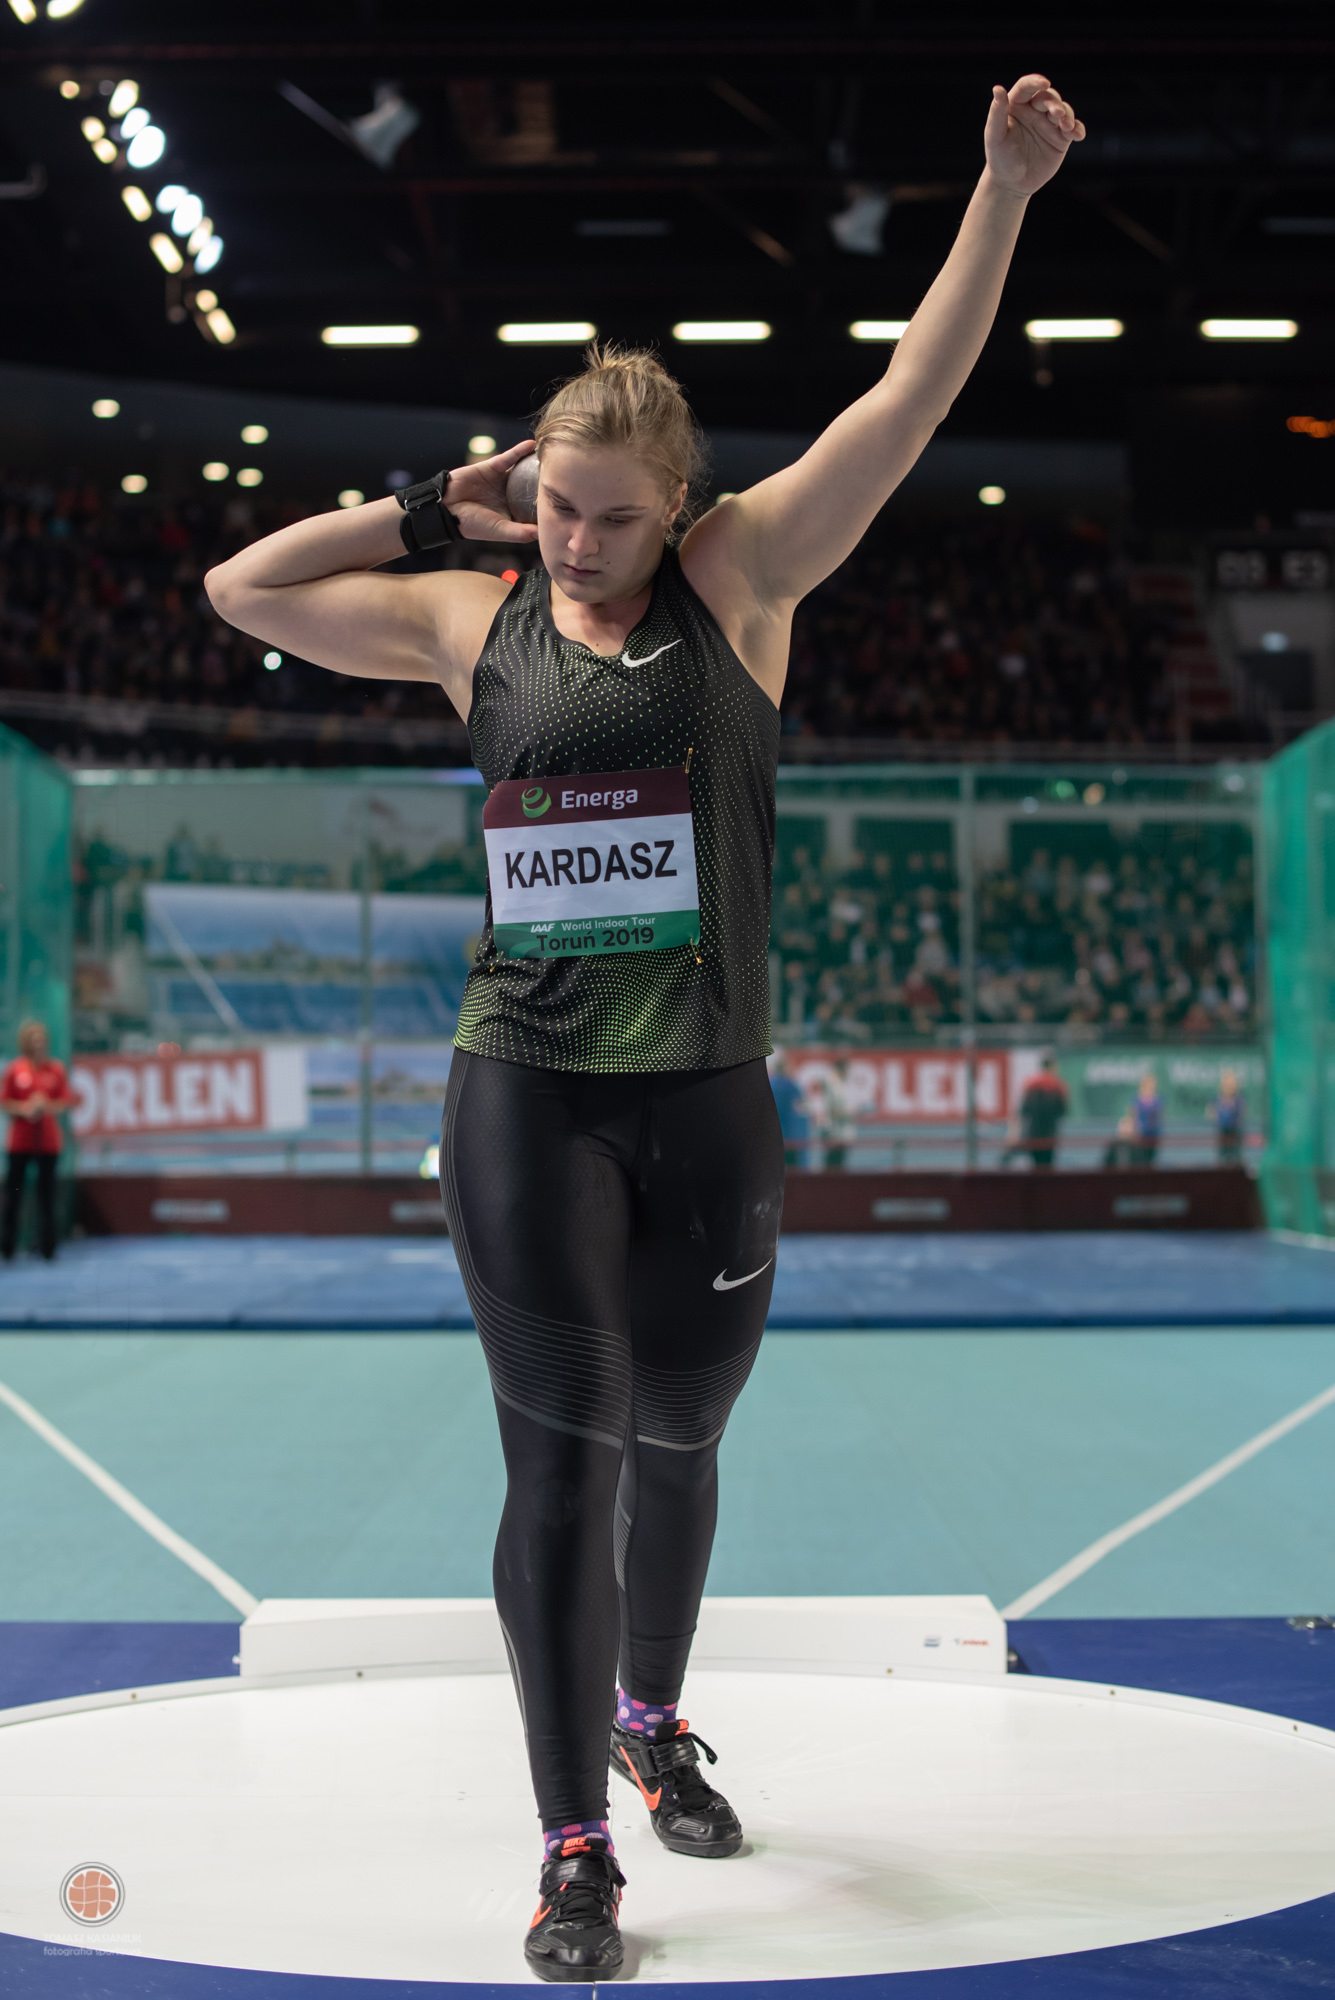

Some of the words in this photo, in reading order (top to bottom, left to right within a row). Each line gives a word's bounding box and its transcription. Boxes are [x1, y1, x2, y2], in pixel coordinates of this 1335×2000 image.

[561, 789, 638, 810] Energa
[505, 840, 677, 889] KARDASZ
[531, 924, 556, 933] IAAF
[561, 920, 592, 931] World
[594, 919, 629, 929] Indoor
[631, 917, 656, 926] Tour
[537, 932, 596, 951] Toruń
[602, 927, 654, 947] 2019
[563, 1836, 587, 1850] NIKE
